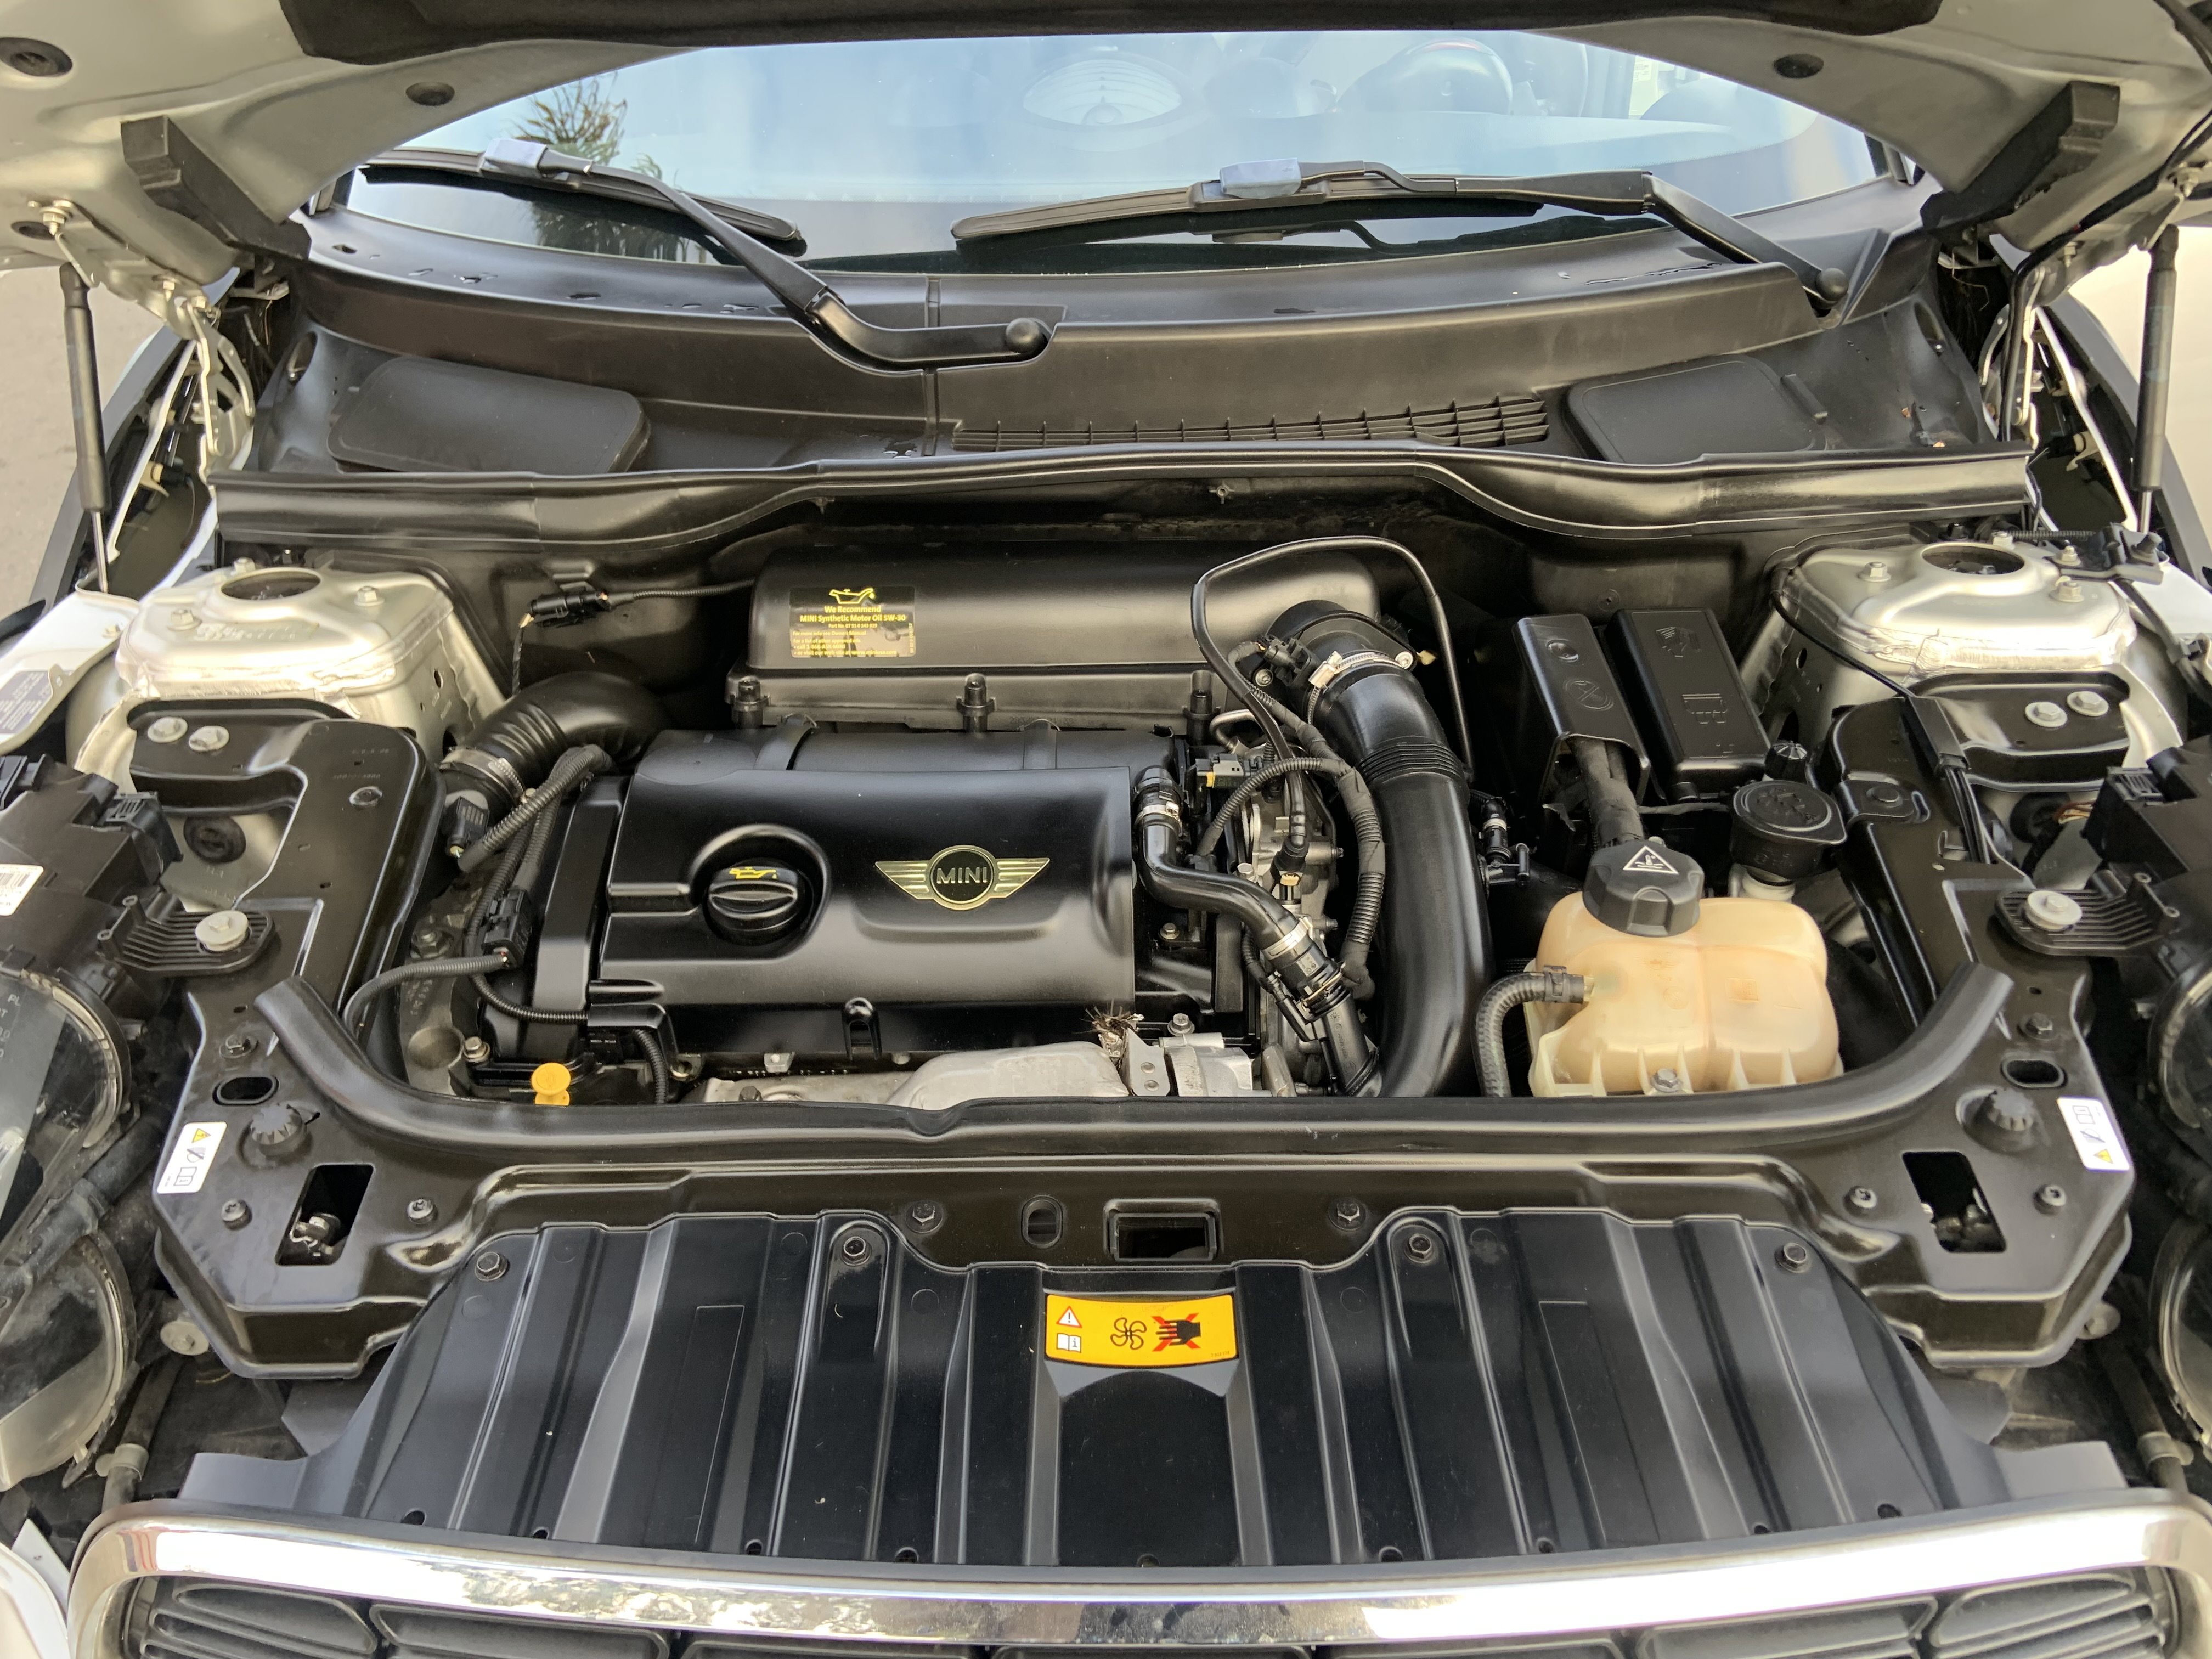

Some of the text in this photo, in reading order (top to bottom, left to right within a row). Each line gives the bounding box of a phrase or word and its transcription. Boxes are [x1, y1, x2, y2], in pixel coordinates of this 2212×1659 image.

[837, 605, 881, 613] Recommend
[817, 614, 849, 624] Synthetic
[936, 867, 988, 884] MINI
